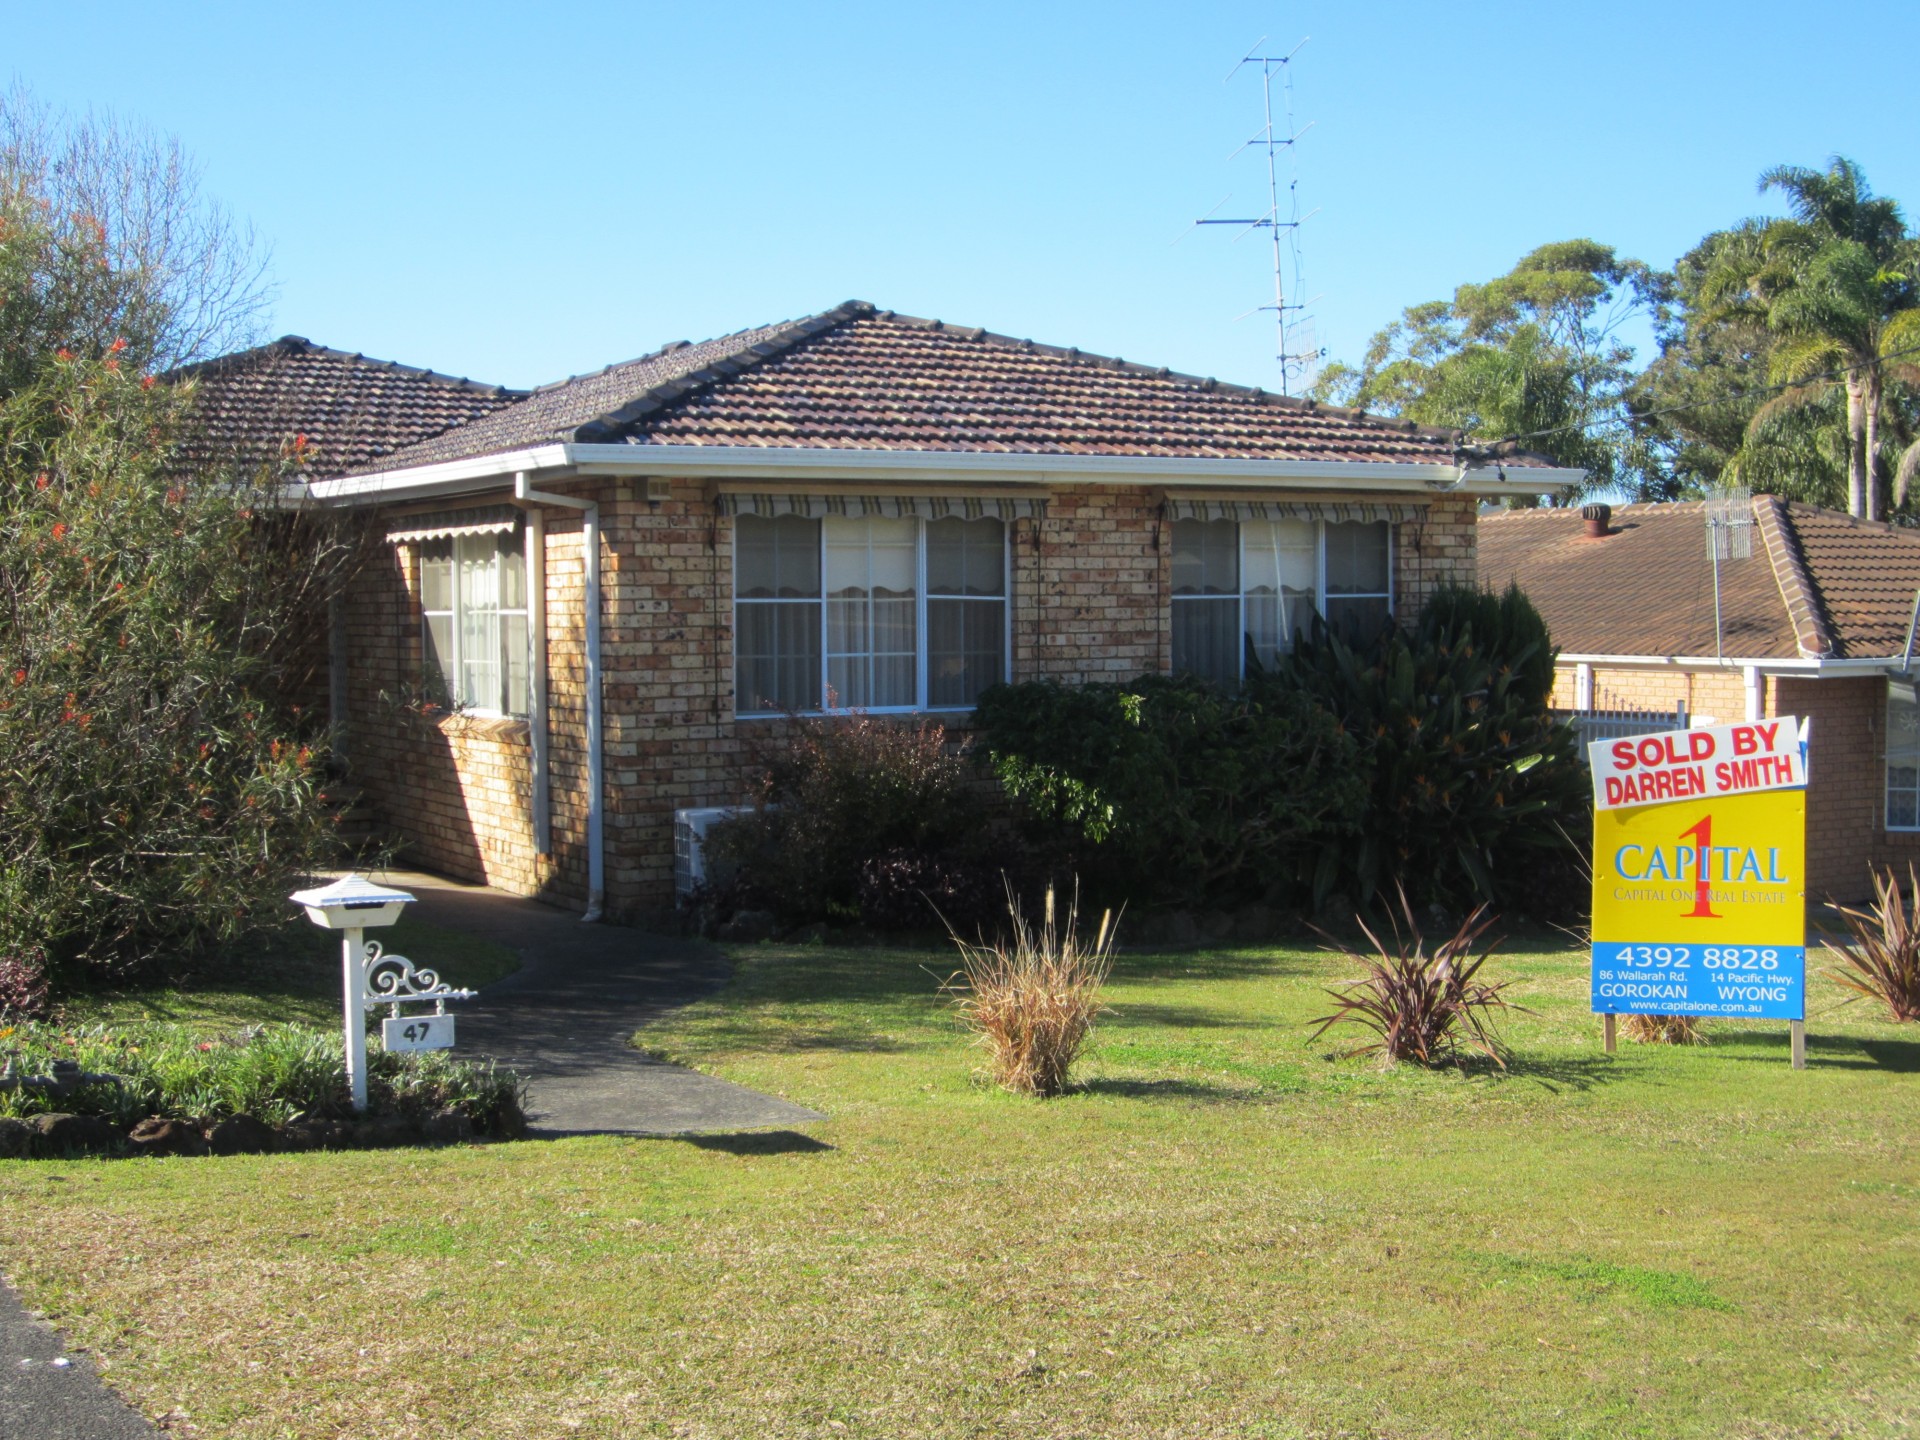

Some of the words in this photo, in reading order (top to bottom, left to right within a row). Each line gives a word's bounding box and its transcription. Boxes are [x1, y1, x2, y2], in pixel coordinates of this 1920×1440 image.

[1611, 731, 1716, 771] SOLD
[1731, 722, 1779, 756] BY
[1605, 765, 1706, 806] DARREN
[1715, 754, 1794, 791] SMITH
[1614, 844, 1789, 884] CAPITAL
[1679, 814, 1723, 919] 1
[1615, 946, 1691, 968] 4392
[1702, 948, 1779, 970] 8828
[1599, 970, 1613, 980] 86
[1617, 970, 1666, 981] Wallarah
[1670, 972, 1688, 982] Rd.
[1711, 973, 1724, 982] 14
[1728, 973, 1763, 983] Pacific
[1767, 974, 1794, 986] Hwy.
[1600, 983, 1688, 998] GOROKAN
[1718, 986, 1787, 1001] WYONG
[1630, 1001, 1762, 1013] www.capitalone.com.au
[403, 1022, 430, 1043] 47
